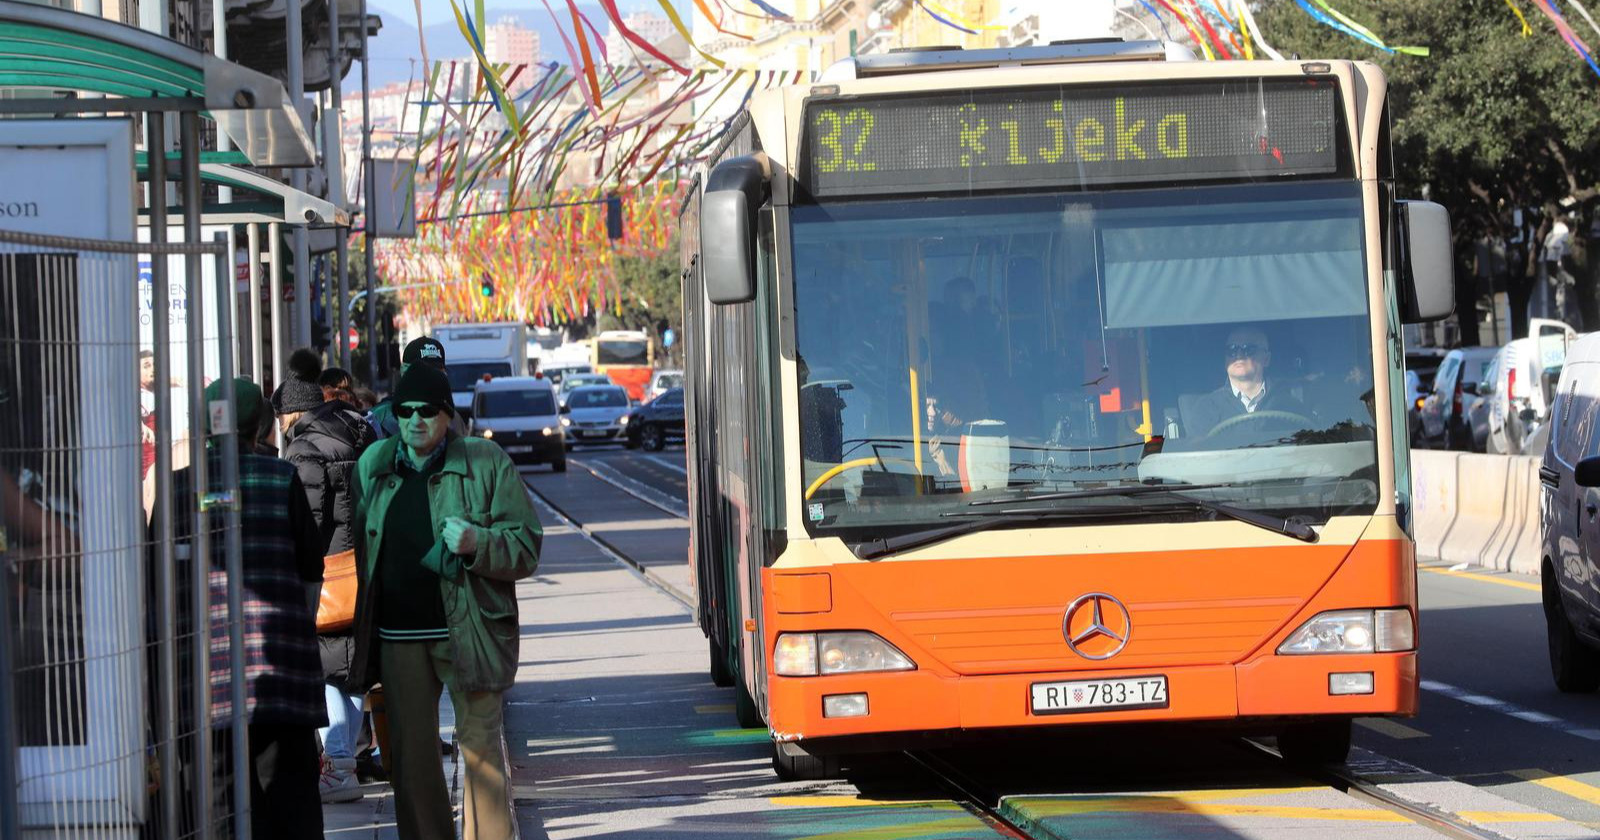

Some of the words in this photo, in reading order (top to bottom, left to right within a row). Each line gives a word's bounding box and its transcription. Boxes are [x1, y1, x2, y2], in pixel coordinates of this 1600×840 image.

[814, 107, 877, 173] 32
[1046, 686, 1068, 708] RI
[1087, 681, 1163, 704] 783-TZ
